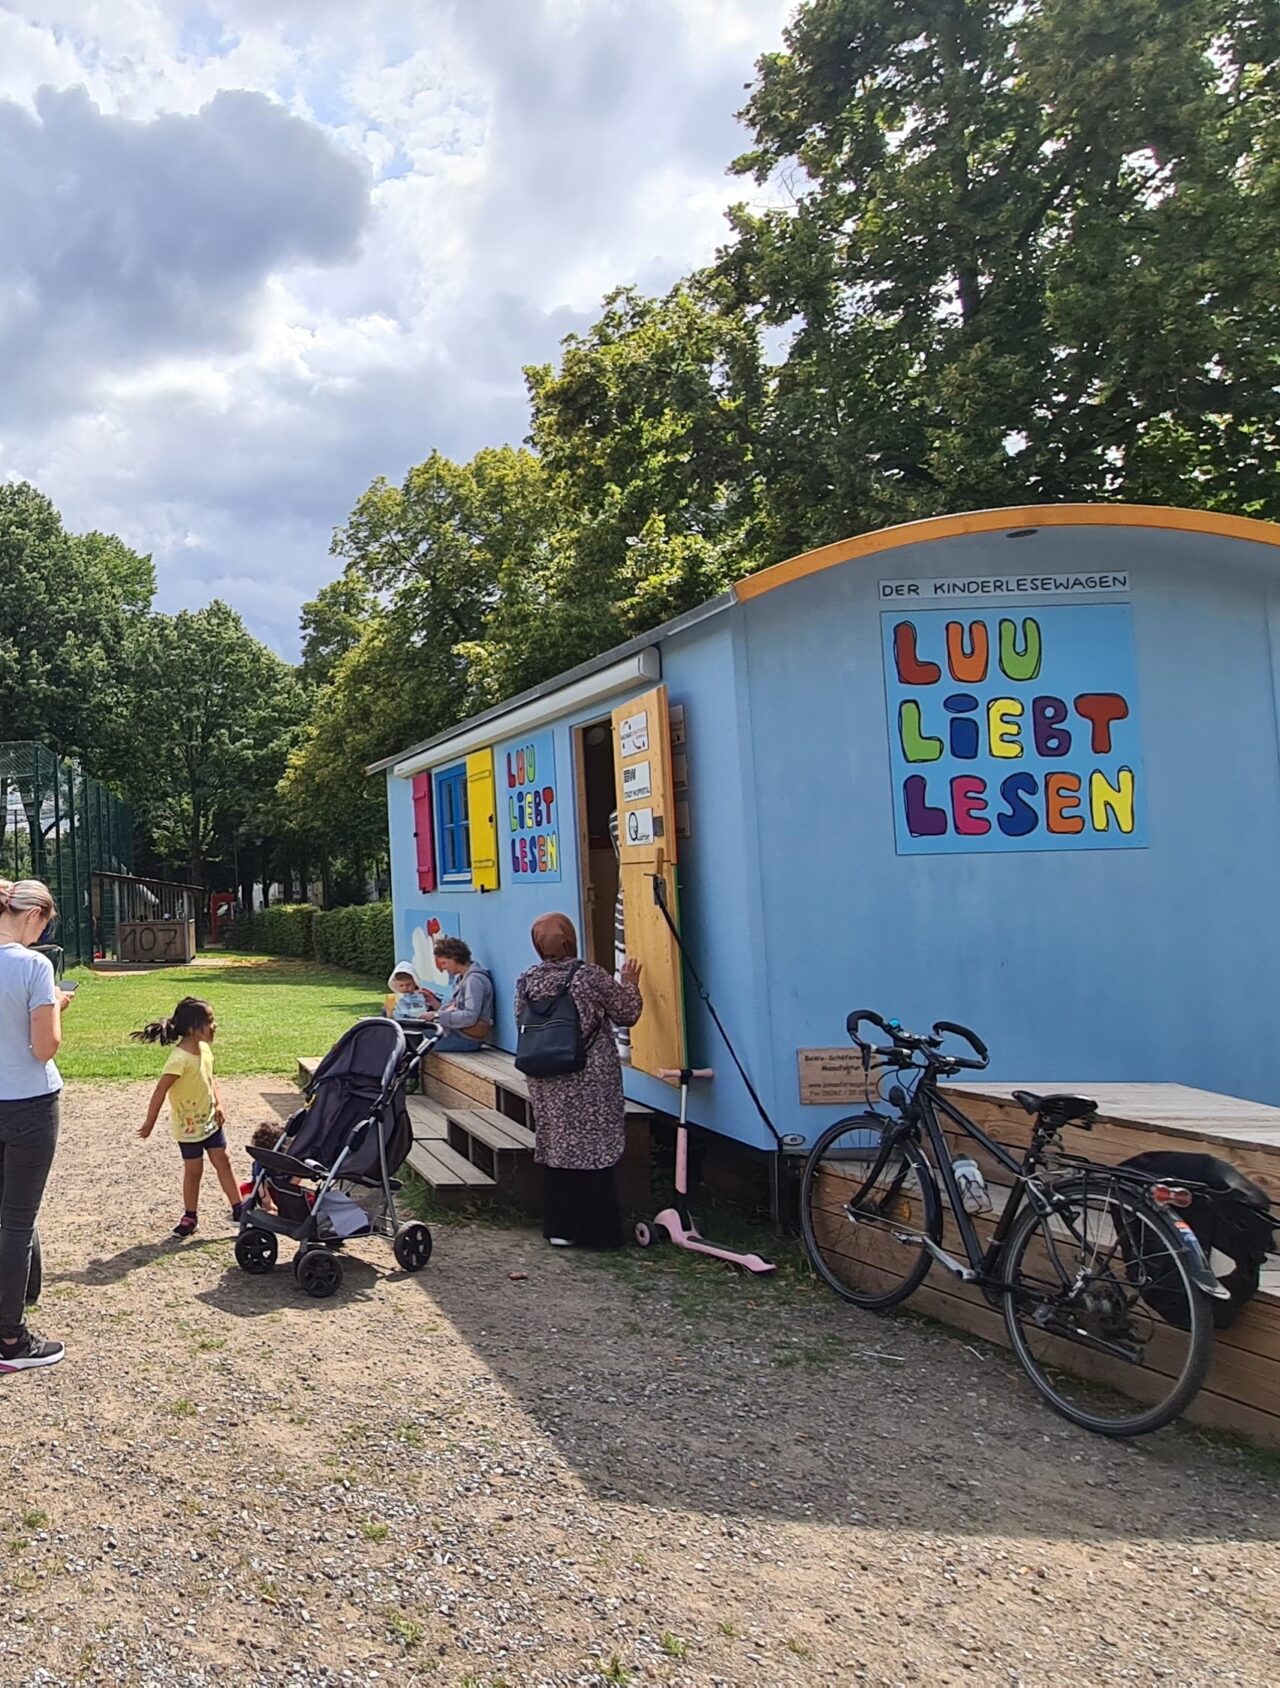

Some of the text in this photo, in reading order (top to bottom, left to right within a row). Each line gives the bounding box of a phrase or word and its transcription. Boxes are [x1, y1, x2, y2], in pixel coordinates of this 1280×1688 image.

[881, 575, 1128, 598] DER KINDERLESEWAGEN
[893, 616, 1042, 685] LUU
[506, 744, 536, 788] LUU
[902, 765, 1135, 838] LESEN
[510, 830, 558, 873] LESEN
